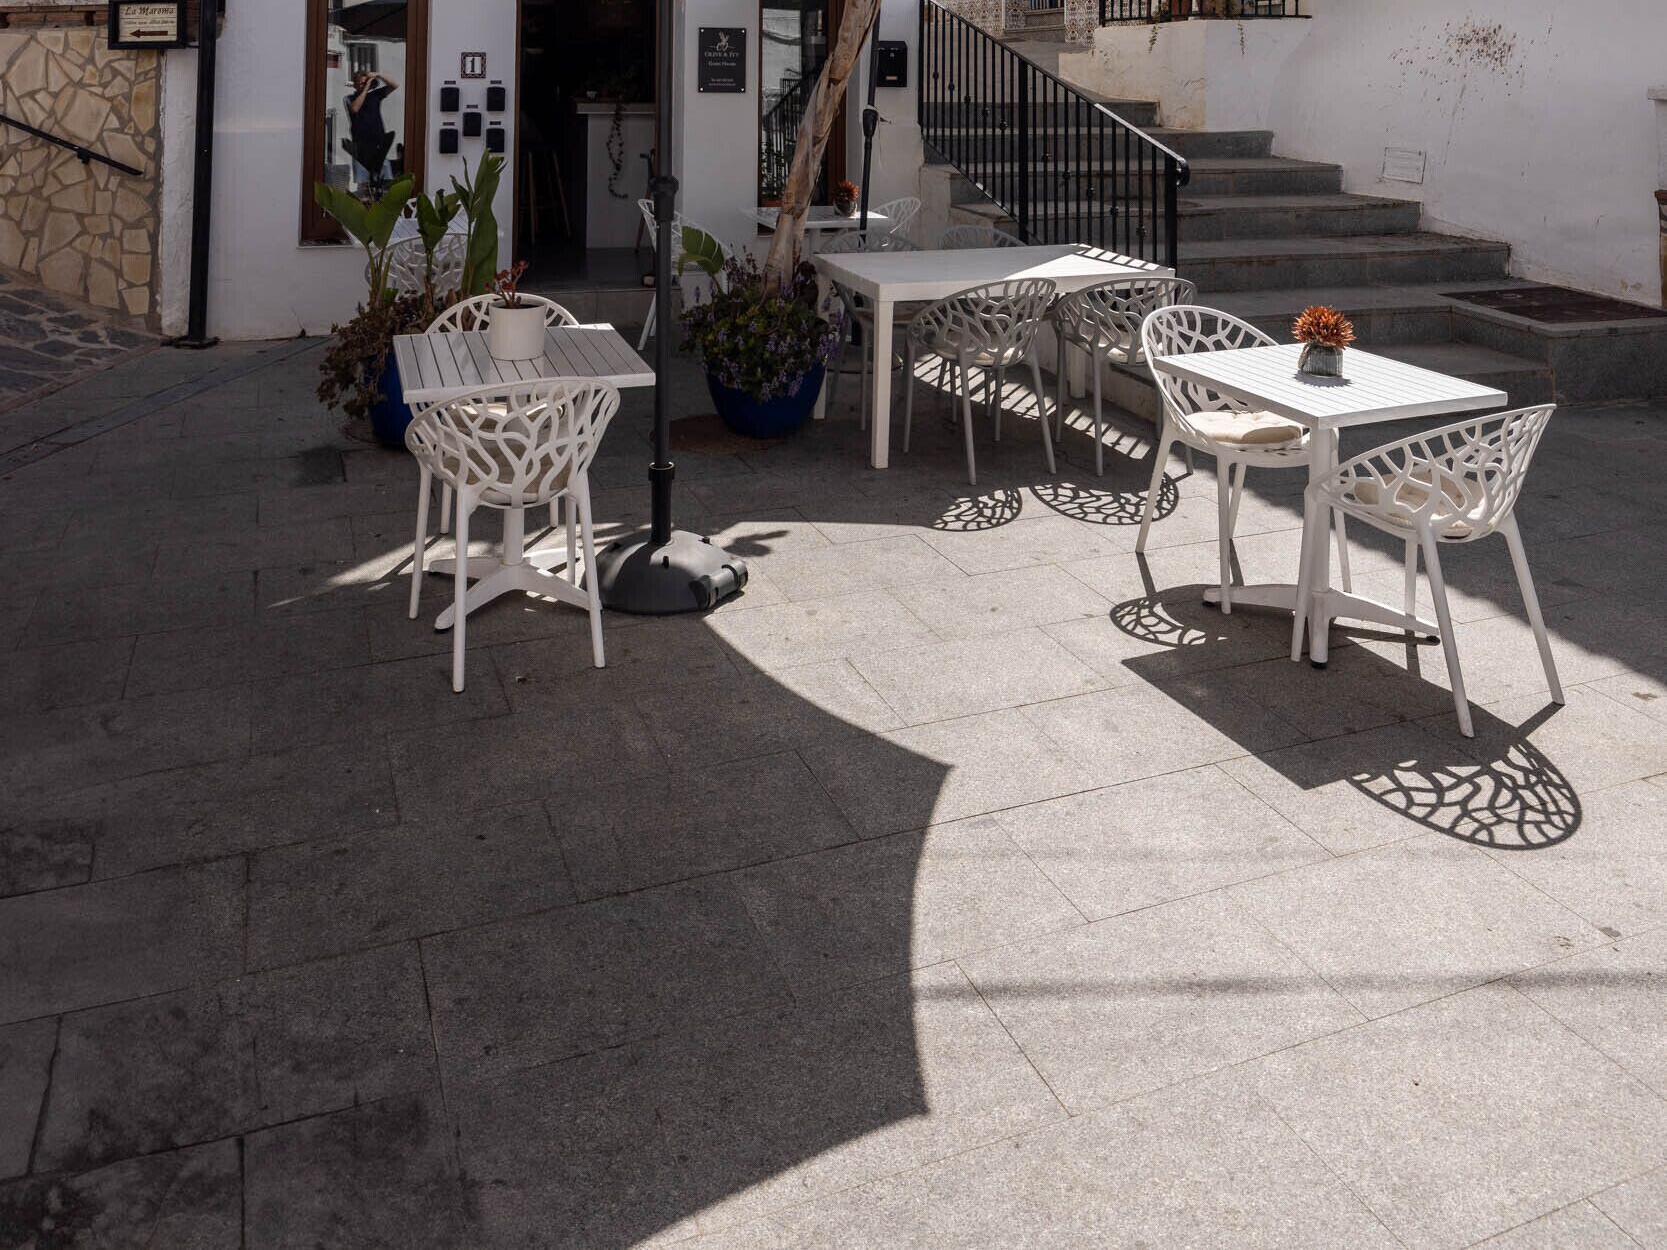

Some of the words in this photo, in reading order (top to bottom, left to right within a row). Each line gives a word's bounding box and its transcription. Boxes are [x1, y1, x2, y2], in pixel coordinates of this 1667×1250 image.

[124, 6, 136, 16] La
[138, 6, 174, 16] Maroma
[470, 57, 475, 73] 1
